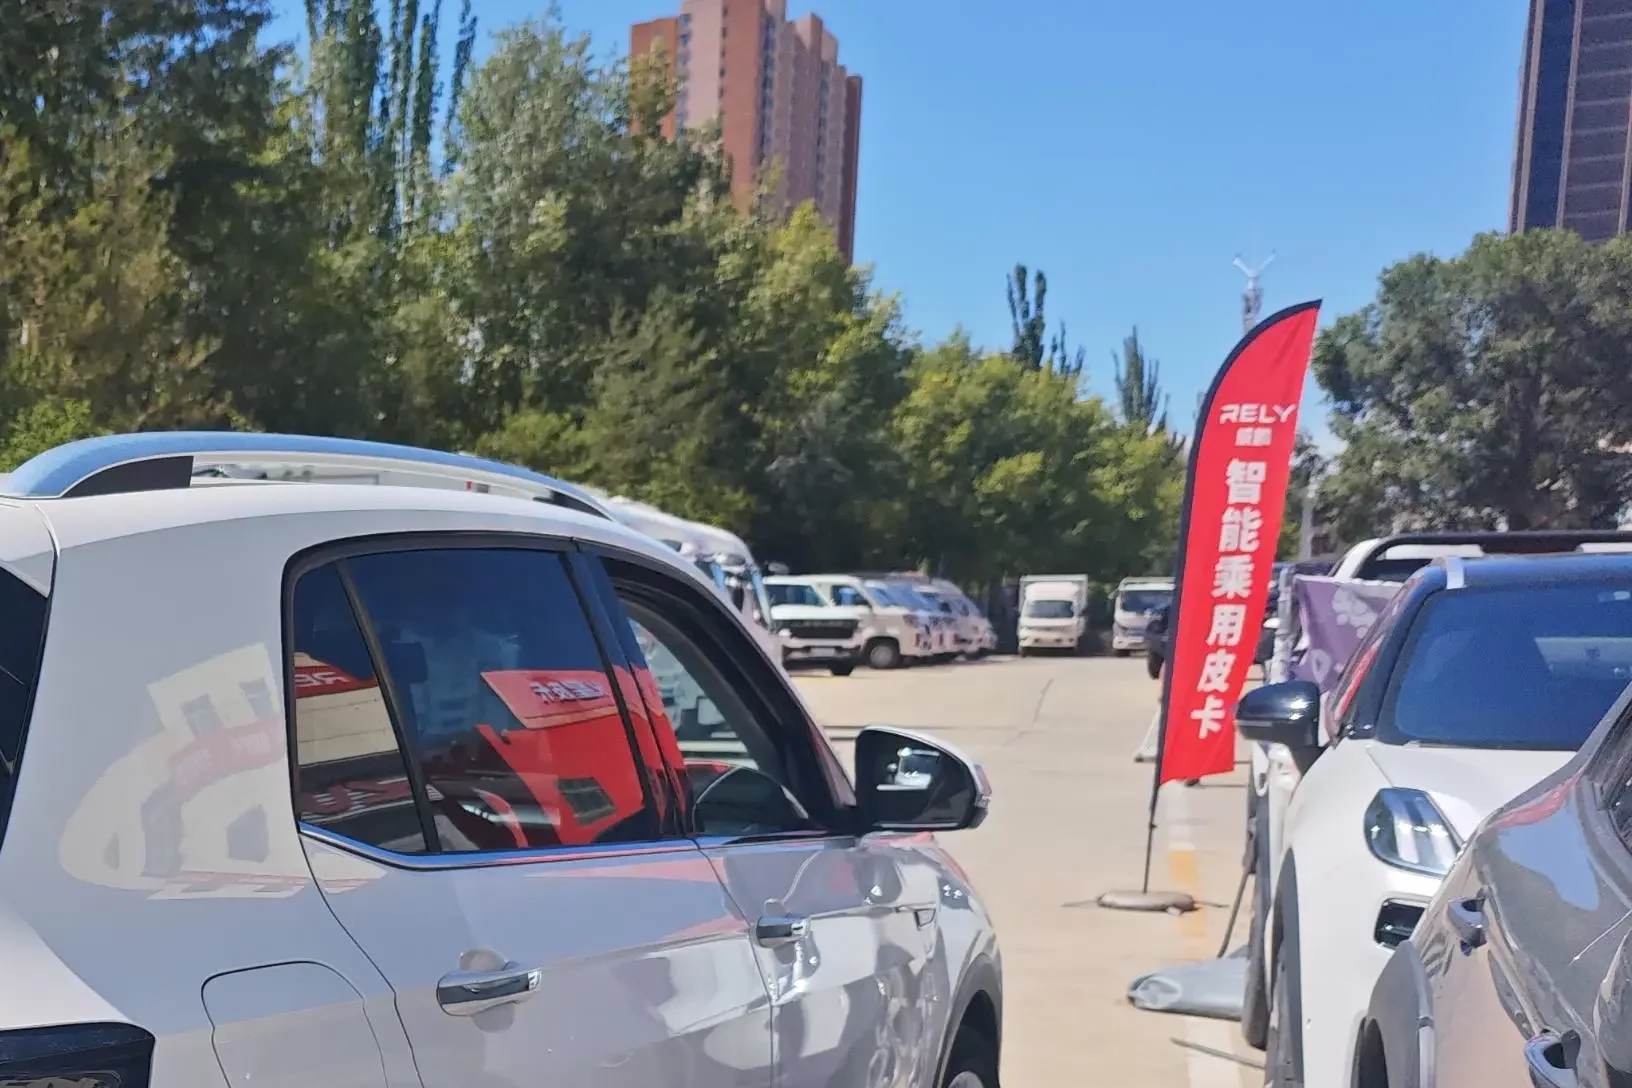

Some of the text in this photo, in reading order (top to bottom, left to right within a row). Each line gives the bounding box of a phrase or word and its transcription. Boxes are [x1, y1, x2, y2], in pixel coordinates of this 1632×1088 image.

[1219, 403, 1297, 425] RELY
[1190, 457, 1268, 740] 智能乘用皮卡
